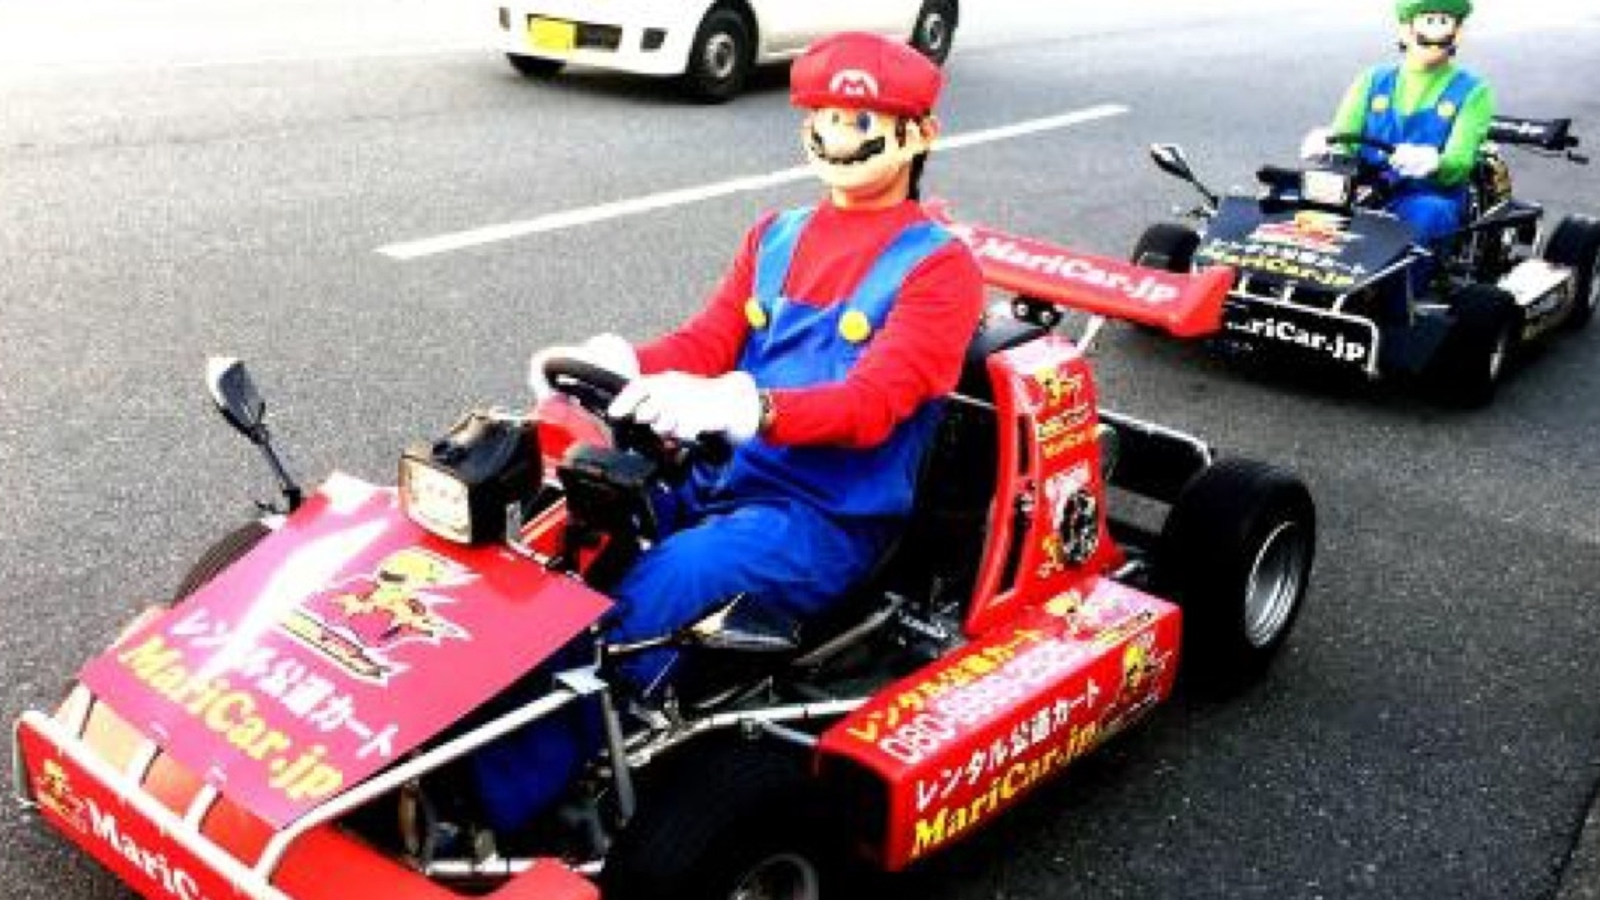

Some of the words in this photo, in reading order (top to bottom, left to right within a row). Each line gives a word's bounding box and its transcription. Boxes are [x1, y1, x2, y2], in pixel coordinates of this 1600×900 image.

[980, 236, 1180, 304] MariCar.jp
[1227, 317, 1366, 361] riCar.jp
[118, 637, 343, 800] MariCar.jp
[909, 720, 1097, 859] MariCar.jp
[86, 797, 206, 900] MariC
